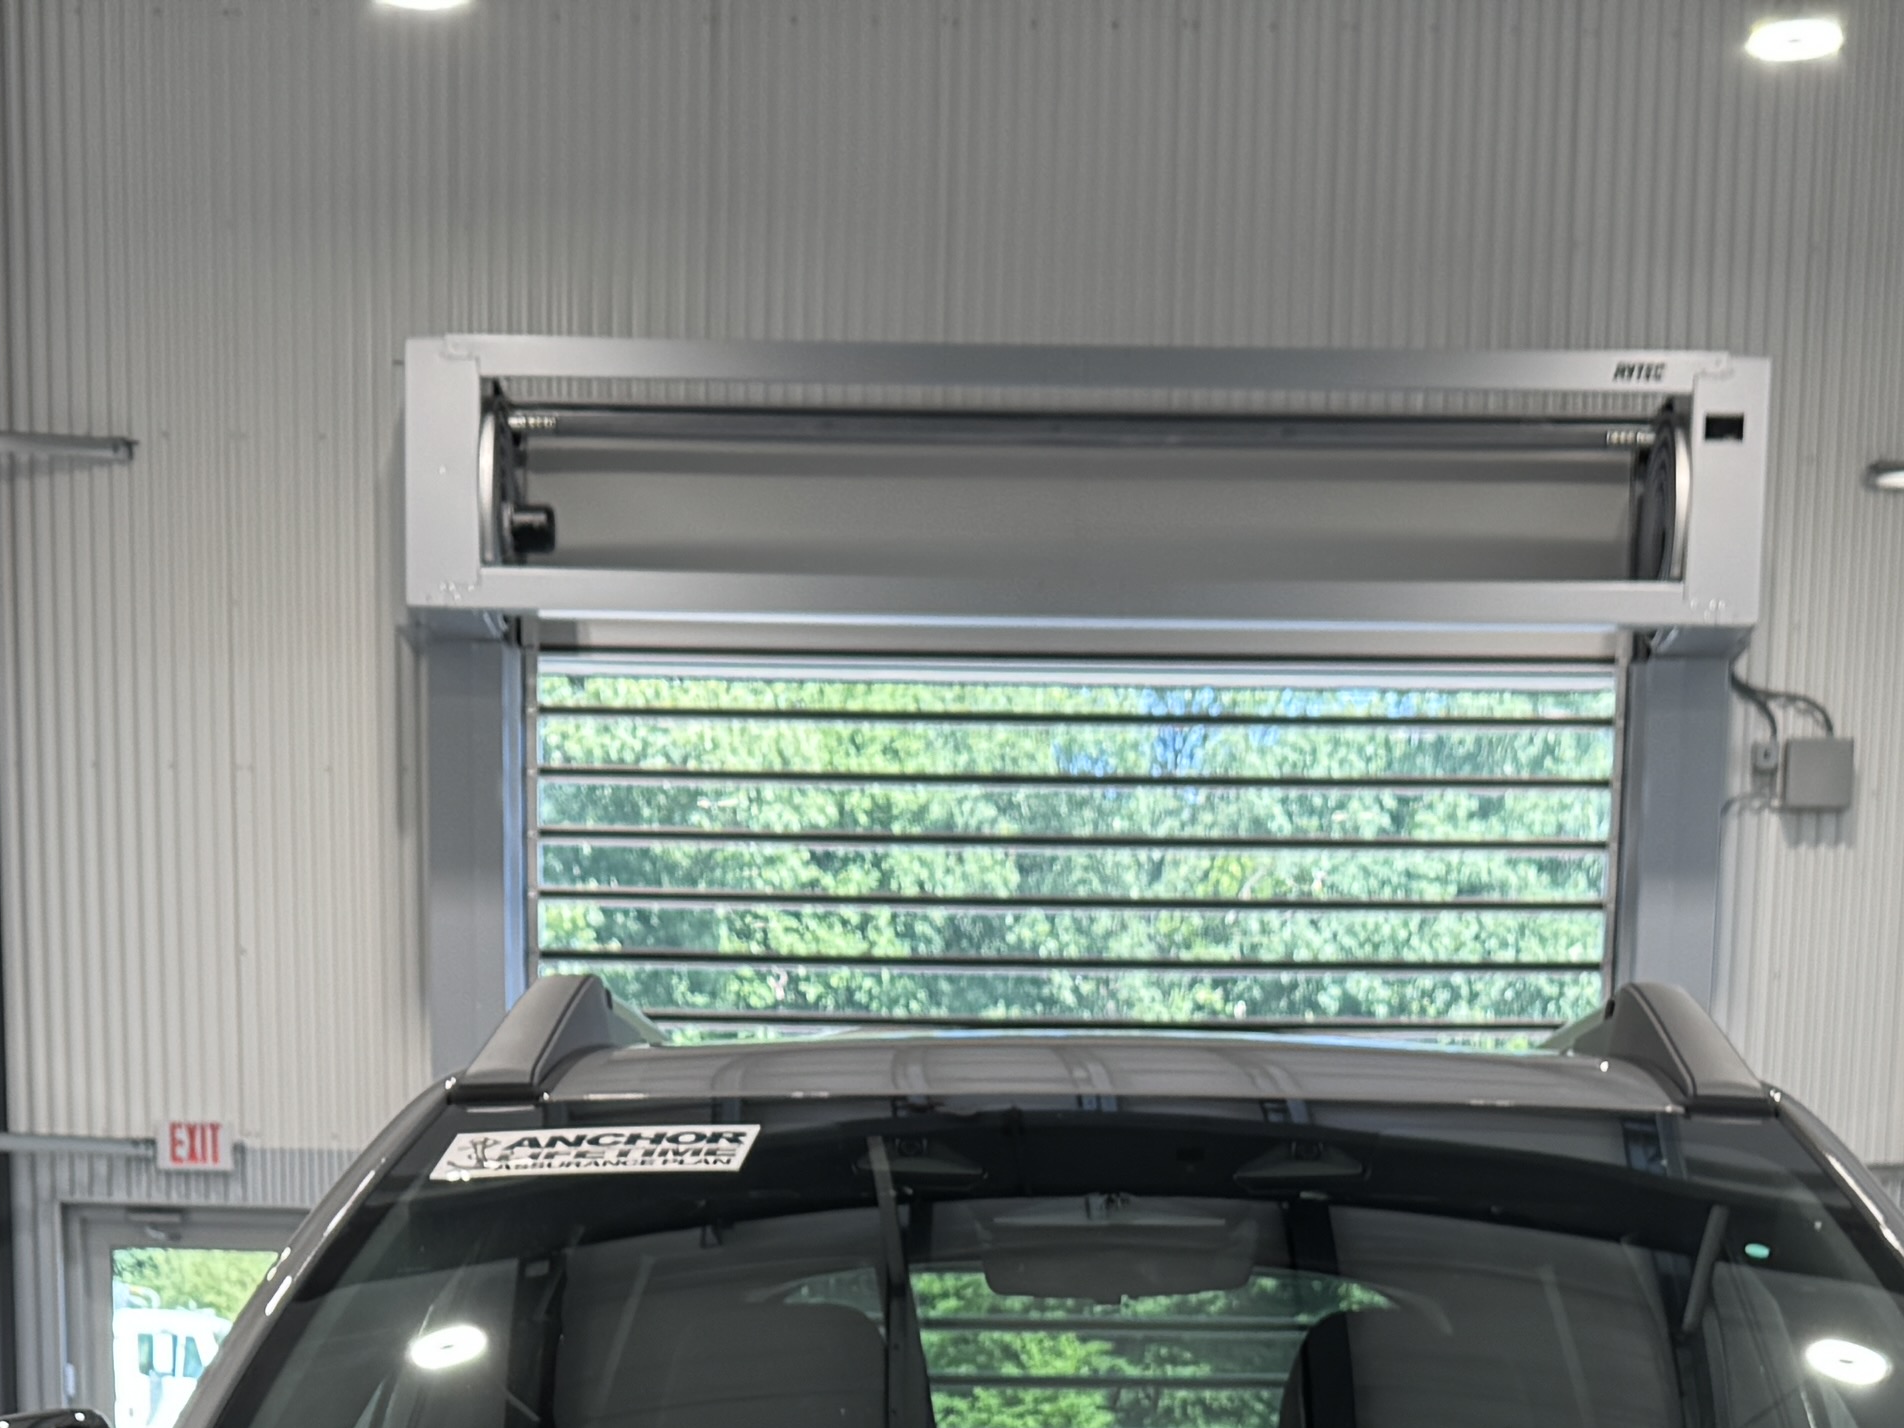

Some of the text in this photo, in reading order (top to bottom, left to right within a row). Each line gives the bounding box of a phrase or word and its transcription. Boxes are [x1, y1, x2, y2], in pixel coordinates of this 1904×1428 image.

[169, 1122, 223, 1165] EXIT
[502, 1131, 747, 1150] ANCHOR
[662, 1157, 733, 1166] PLAN
